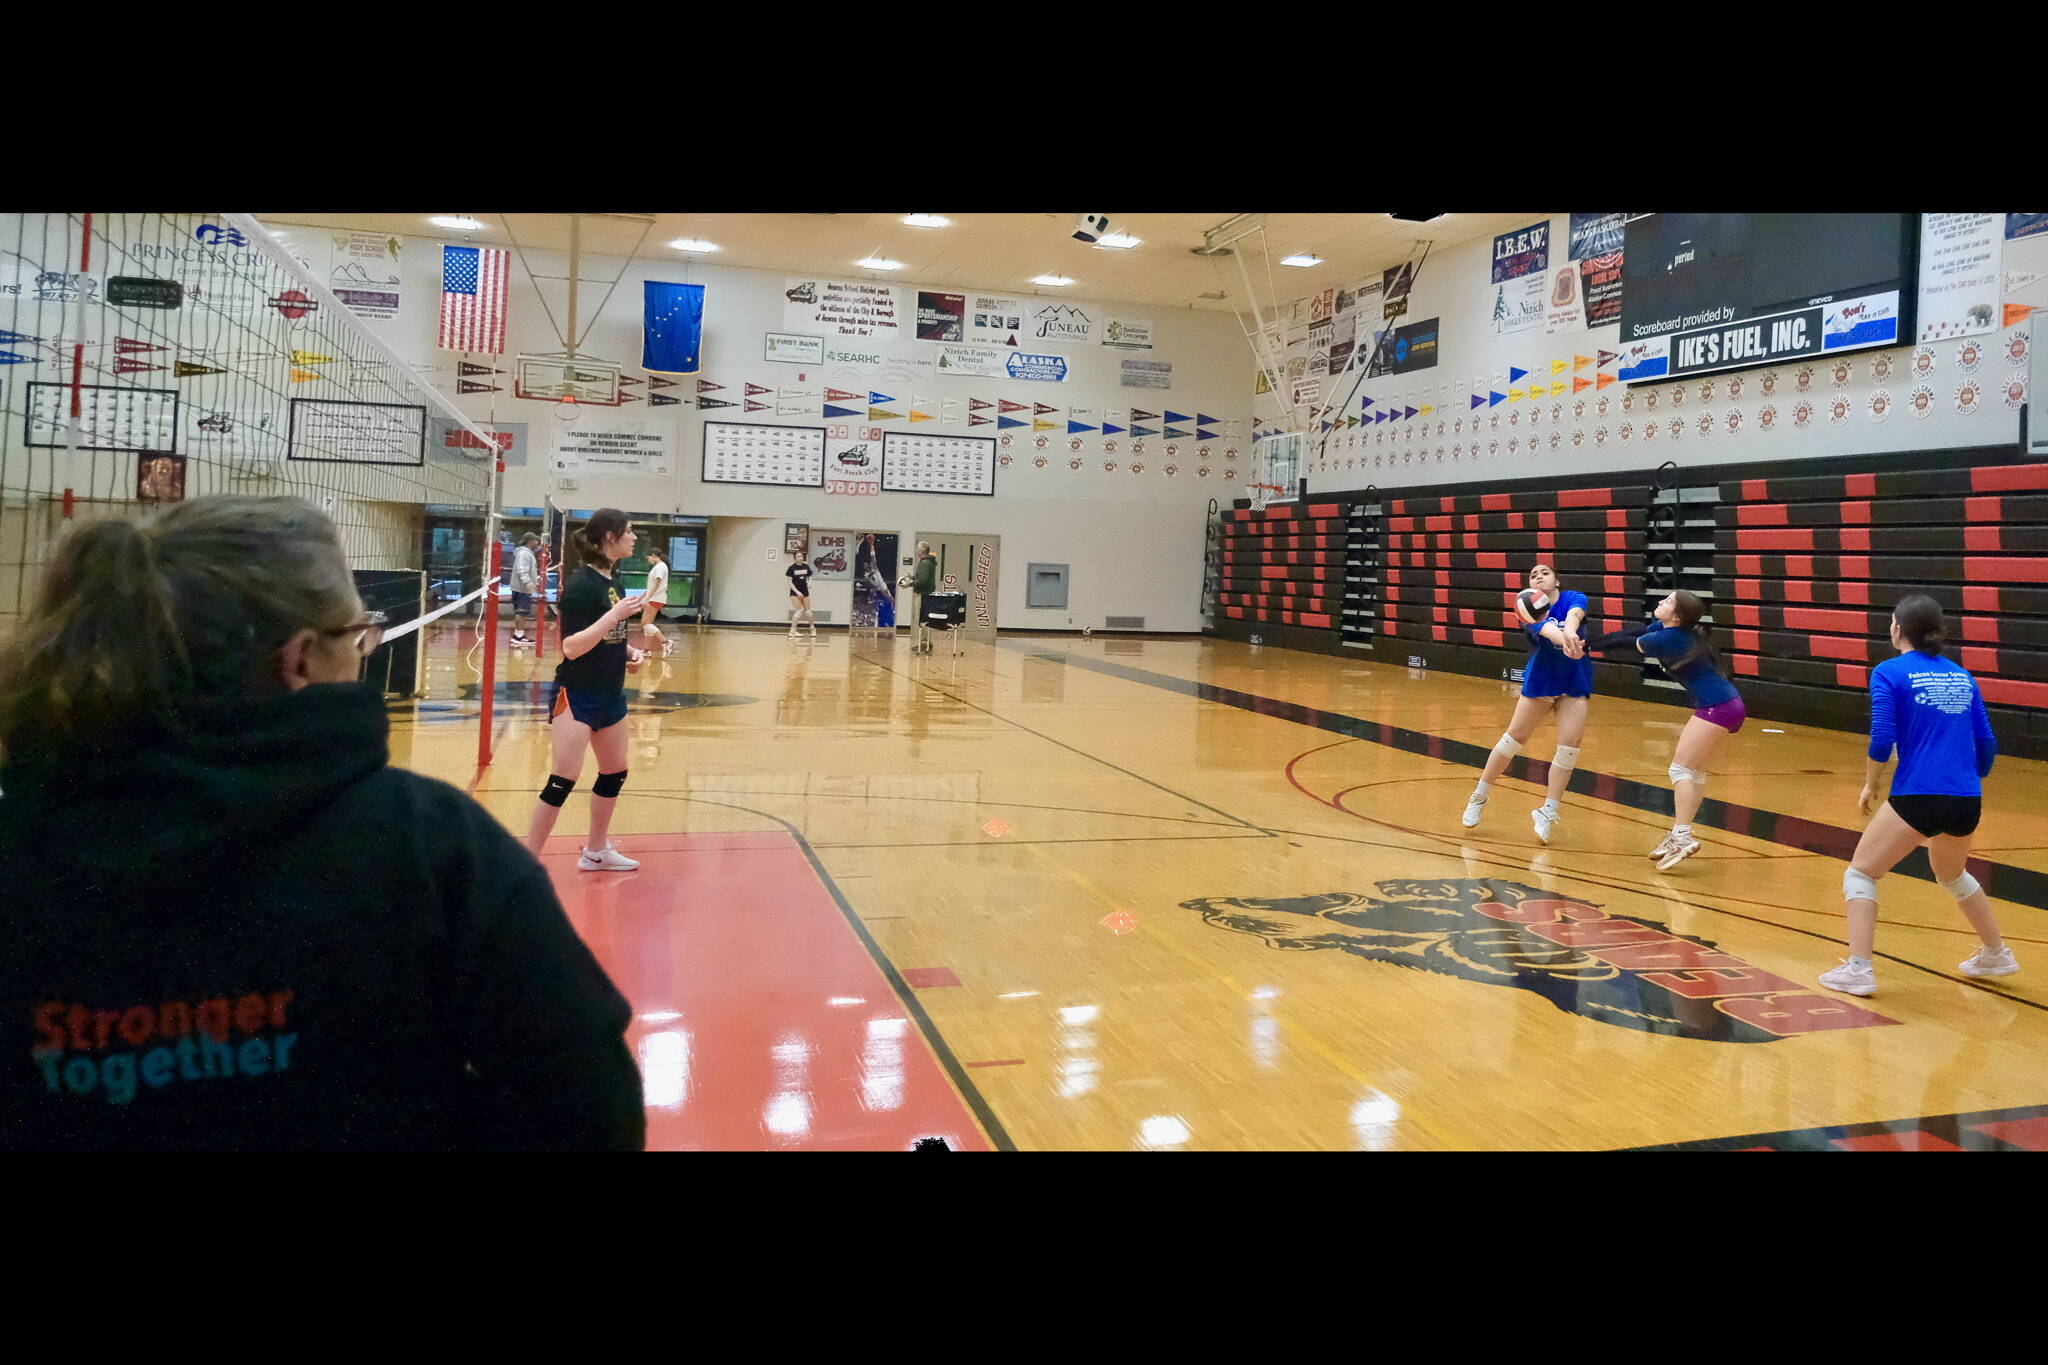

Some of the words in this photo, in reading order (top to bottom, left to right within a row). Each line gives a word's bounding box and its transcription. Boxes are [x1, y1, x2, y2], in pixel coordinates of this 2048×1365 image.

[1496, 227, 1546, 260] I.B.E.W.
[133, 242, 226, 264] PRINCESS
[232, 250, 310, 270] CRUS
[1674, 249, 1694, 267] period
[0, 284, 22, 295] rs!
[828, 283, 843, 291] Juneau
[1519, 299, 1544, 316] Nizich
[1036, 316, 1089, 338] JUNEAU
[1633, 320, 1681, 337] Scoreboard
[1681, 310, 1721, 330] provided
[1723, 306, 1736, 321] by
[838, 326, 856, 335] Thank
[858, 327, 868, 336] You
[1068, 333, 1088, 341] MALL
[1123, 332, 1149, 340] Oncology
[776, 338, 797, 346] FIRST
[799, 340, 820, 348] BANK
[1677, 333, 1719, 369] IKE'S
[1722, 326, 1767, 363] FUEL,
[1771, 317, 1811, 353] INC.
[837, 352, 881, 365] SEARHC
[944, 347, 969, 356] Nizich
[971, 349, 998, 358] Family
[958, 355, 984, 364] Dental
[1008, 353, 1064, 367] ALASKA
[974, 543, 994, 628] UNLEASHED!
[33, 988, 295, 1050] Stronger
[33, 1032, 298, 1105] Together
